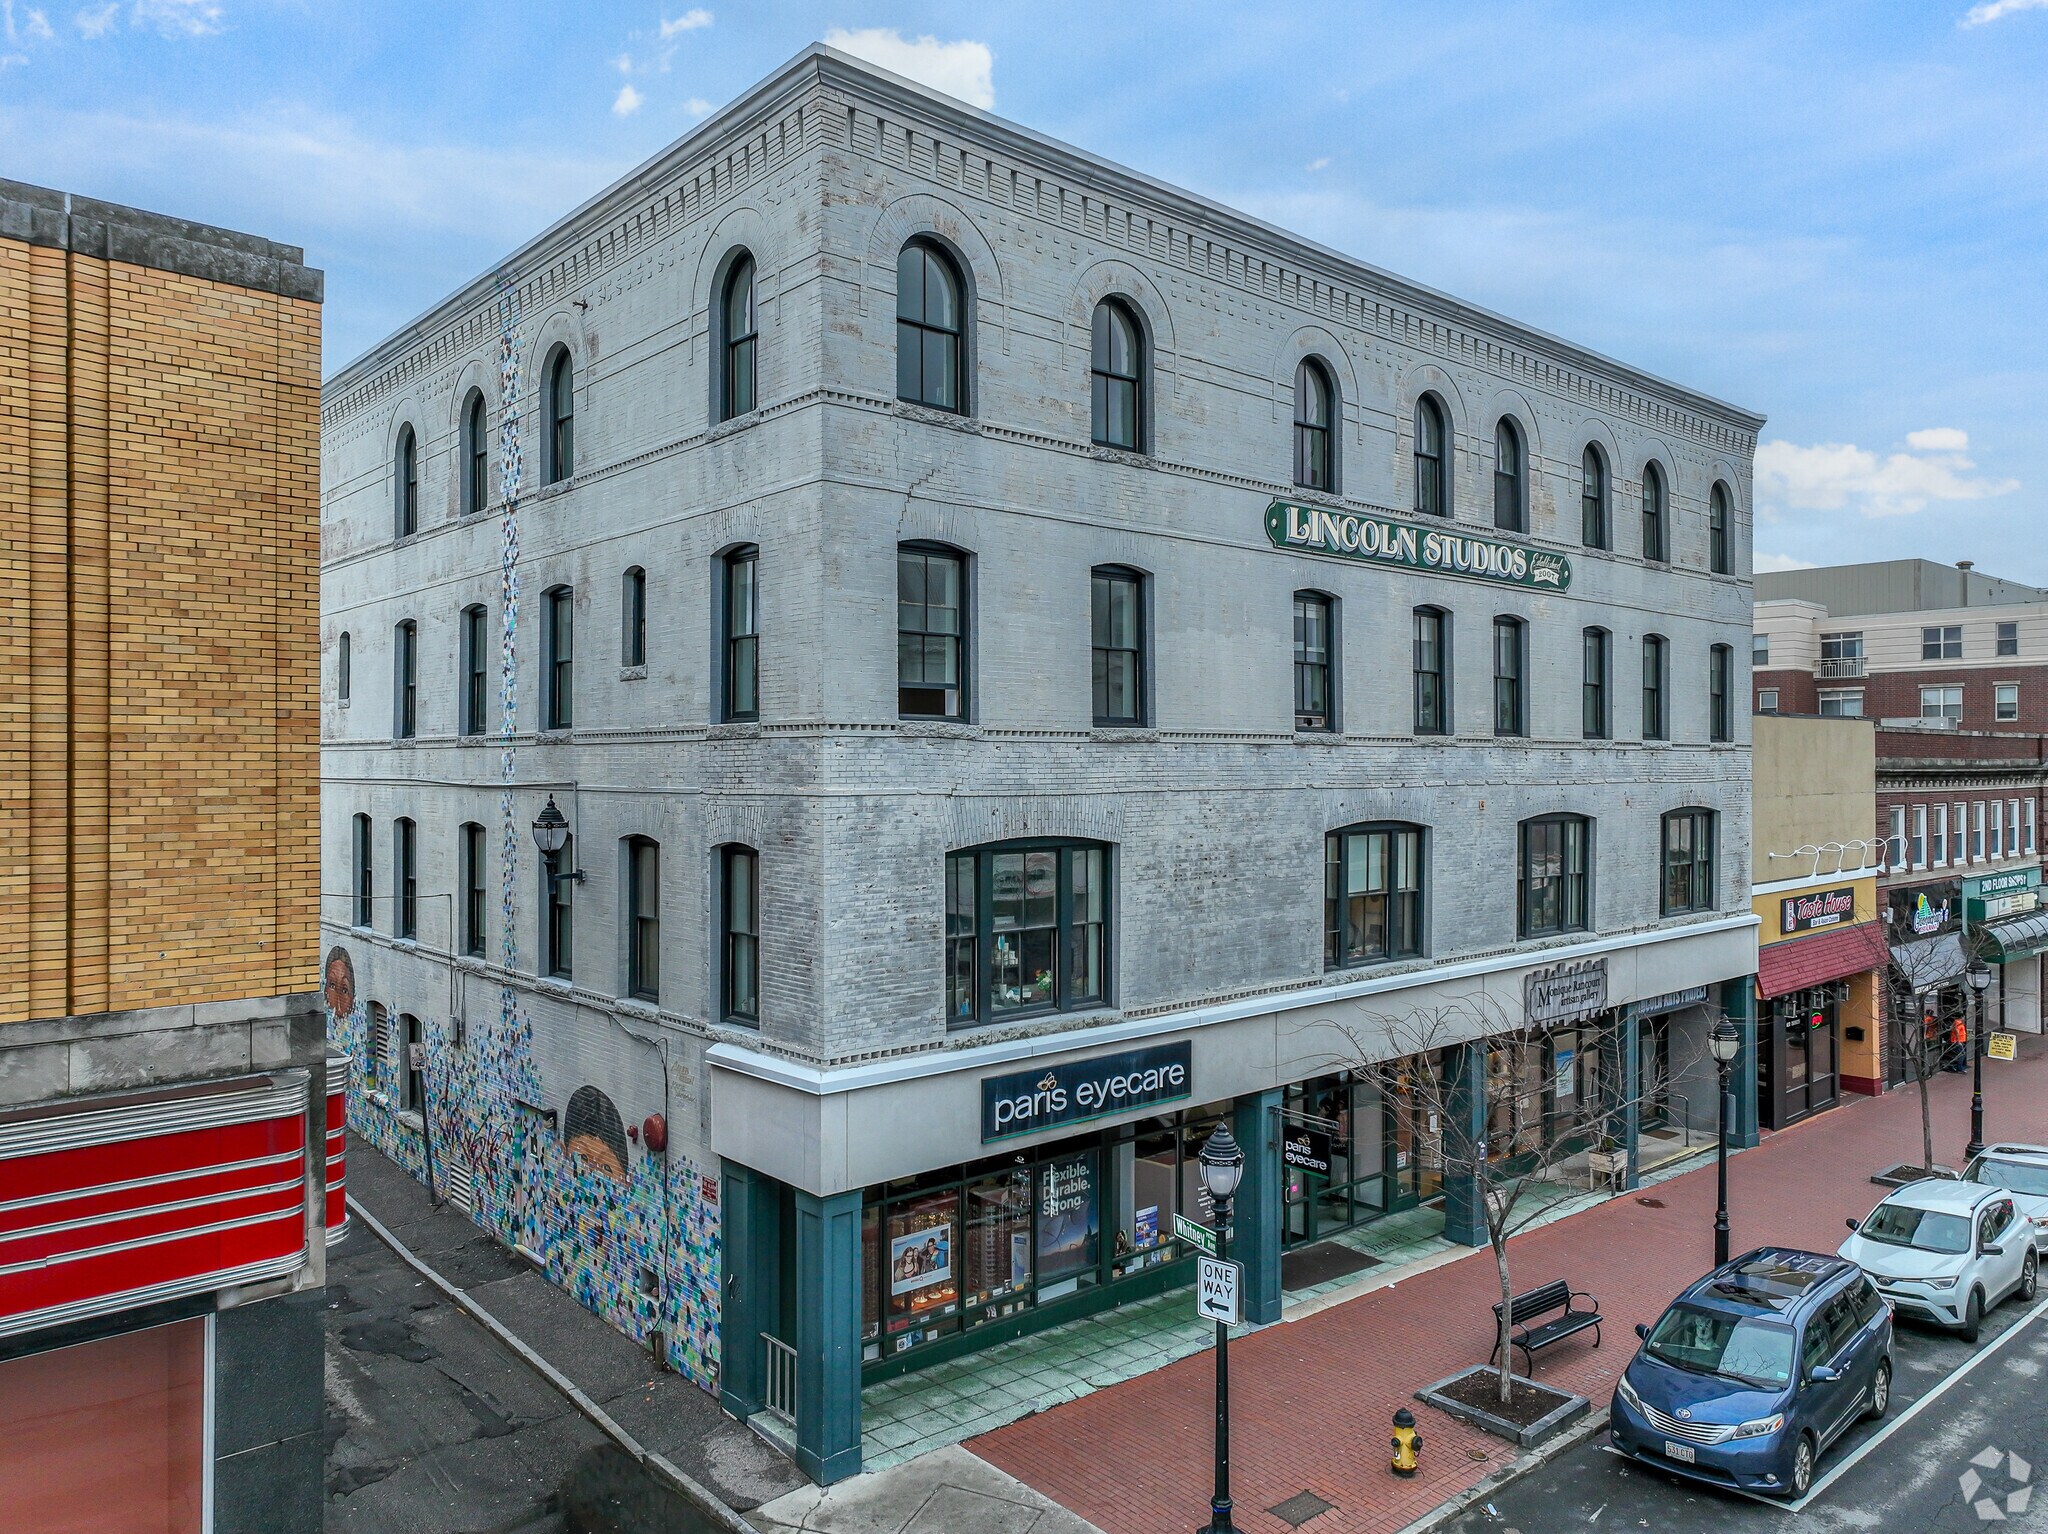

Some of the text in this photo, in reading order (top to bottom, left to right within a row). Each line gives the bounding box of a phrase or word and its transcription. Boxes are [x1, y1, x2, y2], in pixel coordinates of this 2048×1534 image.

[1287, 506, 1527, 580] LINCOLN STUDIOS
[1537, 569, 1557, 581] 2007
[1992, 877, 2008, 890] FLOOR
[1797, 895, 1823, 920] Taste
[1823, 892, 1852, 915] House
[1537, 977, 1601, 1008] Monique Rancourt
[1561, 988, 1599, 1007] artisan gallery
[994, 1064, 1184, 1131] paris eyecare
[1285, 1139, 1312, 1156] paris
[1285, 1151, 1328, 1172] eyecare
[1042, 1162, 1090, 1186] Fexible.
[1042, 1195, 1085, 1216] Srong.
[1176, 1216, 1205, 1248] Whitney
[1204, 1264, 1233, 1284] ONE
[1203, 1280, 1233, 1300] WAY
[1667, 1445, 1679, 1455] 531
